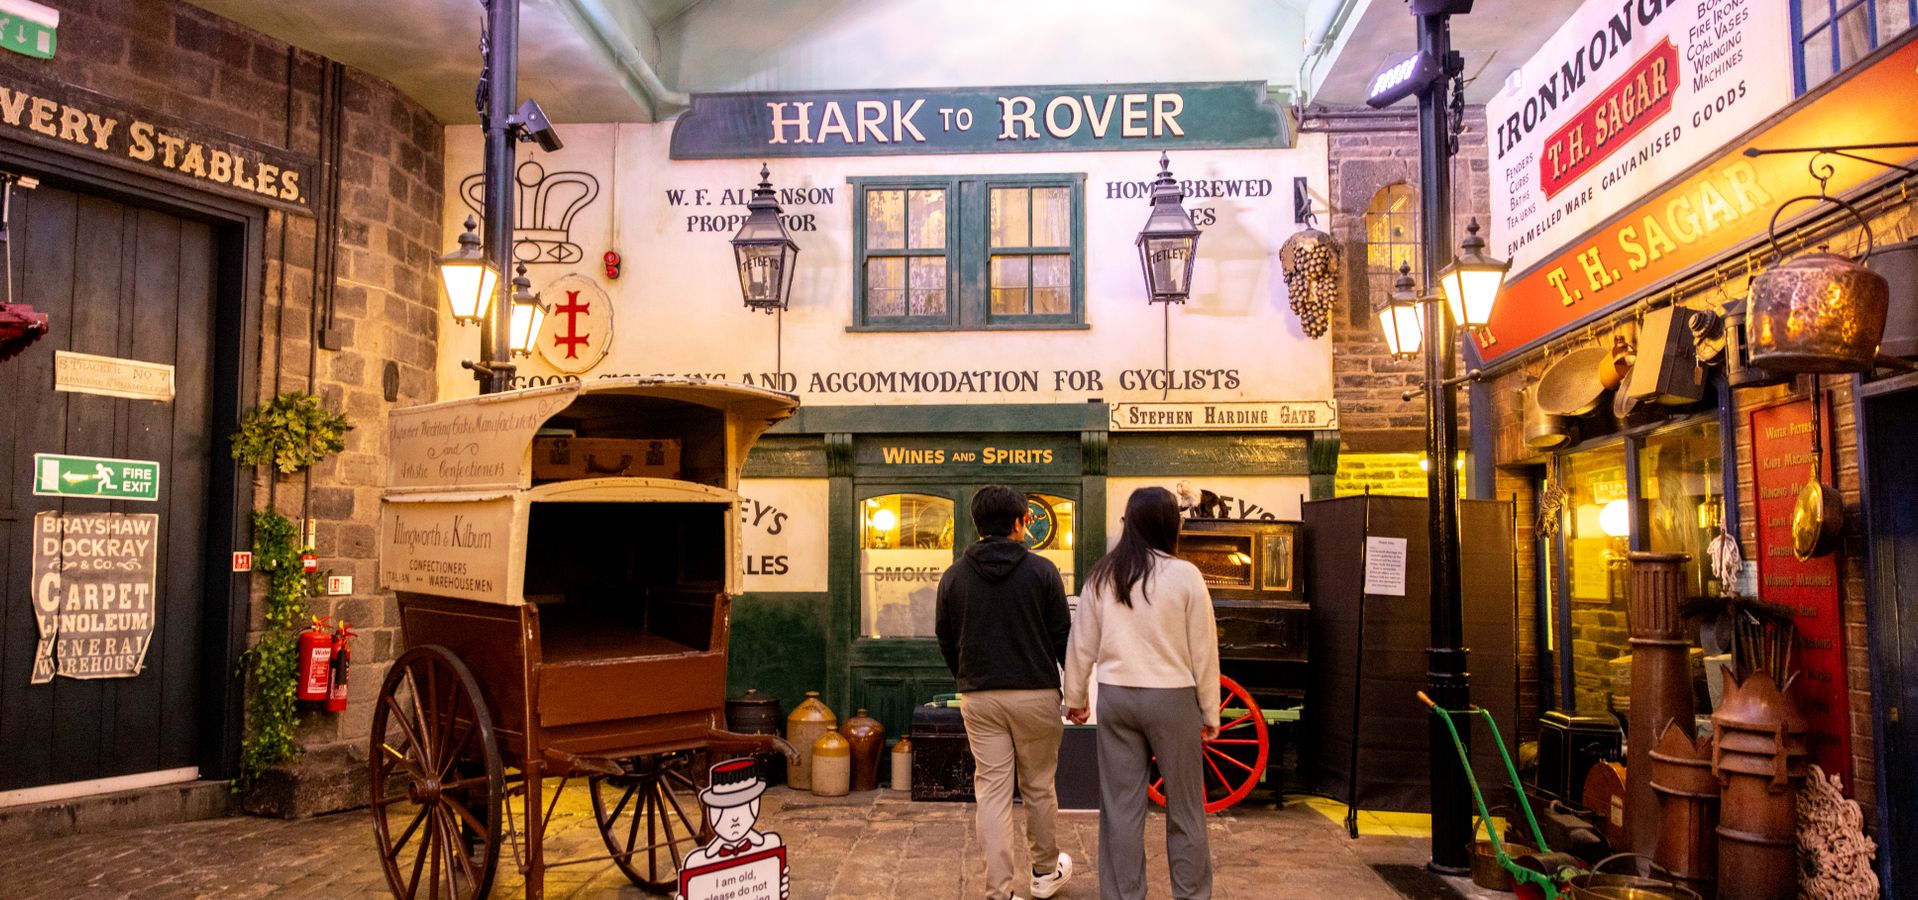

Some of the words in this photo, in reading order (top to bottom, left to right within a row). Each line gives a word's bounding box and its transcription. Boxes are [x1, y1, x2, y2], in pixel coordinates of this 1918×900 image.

[1687, 36, 1713, 61] COAL
[1714, 7, 1749, 40] VASES
[1689, 18, 1711, 43] FIRE
[1693, 30, 1742, 74] WRINGING
[1693, 49, 1743, 94] MACHINES
[1595, 56, 1669, 149] SAGAR
[767, 98, 928, 145] HARK
[939, 107, 974, 132] TO
[997, 92, 1186, 140] ROVER
[128, 120, 306, 204] STABLES.
[1506, 152, 1534, 182] FENDERS
[1508, 208, 1562, 256] ENAMELLED
[1565, 187, 1593, 216] WARE
[1602, 125, 1681, 190] GALVANISED
[1692, 80, 1746, 129] GOODS
[1509, 173, 1529, 194] CURBS
[666, 188, 690, 206] W.
[695, 188, 712, 206] F.
[720, 187, 835, 205] ALNSON
[1510, 190, 1530, 211] BATHS
[1507, 216, 1519, 230] TEA
[1520, 203, 1536, 221] URNS
[1617, 159, 1775, 272] SAGAR
[808, 370, 1038, 393] ACCOMMODATION
[1054, 369, 1104, 392] FOR
[1118, 368, 1241, 391] CYCLISTS
[1129, 405, 1193, 425] STEPHEN
[1204, 405, 1268, 425] HARDING
[1279, 404, 1316, 424] GATE
[442, 443, 460, 455] and
[882, 447, 945, 465] WINES
[952, 452, 977, 462] AND
[982, 447, 1054, 465] SPIRITS
[122, 467, 152, 480] FIRE
[438, 460, 505, 483] Confectioners
[122, 480, 152, 493] EXIT
[42, 516, 152, 536] BRAYSHAW
[393, 514, 440, 554] Illingworth
[42, 537, 150, 557] DOCKRAY
[80, 559, 89, 569] &
[409, 559, 467, 576] CONFECTIONERS
[743, 555, 789, 576] LES
[39, 571, 149, 612] CARPET
[428, 575, 493, 592] WAREHOUSEMEN
[39, 612, 148, 634] LINOLEUM
[721, 876, 736, 887] am
[739, 869, 757, 882] old,
[738, 886, 750, 896] do
[752, 881, 767, 892] not
